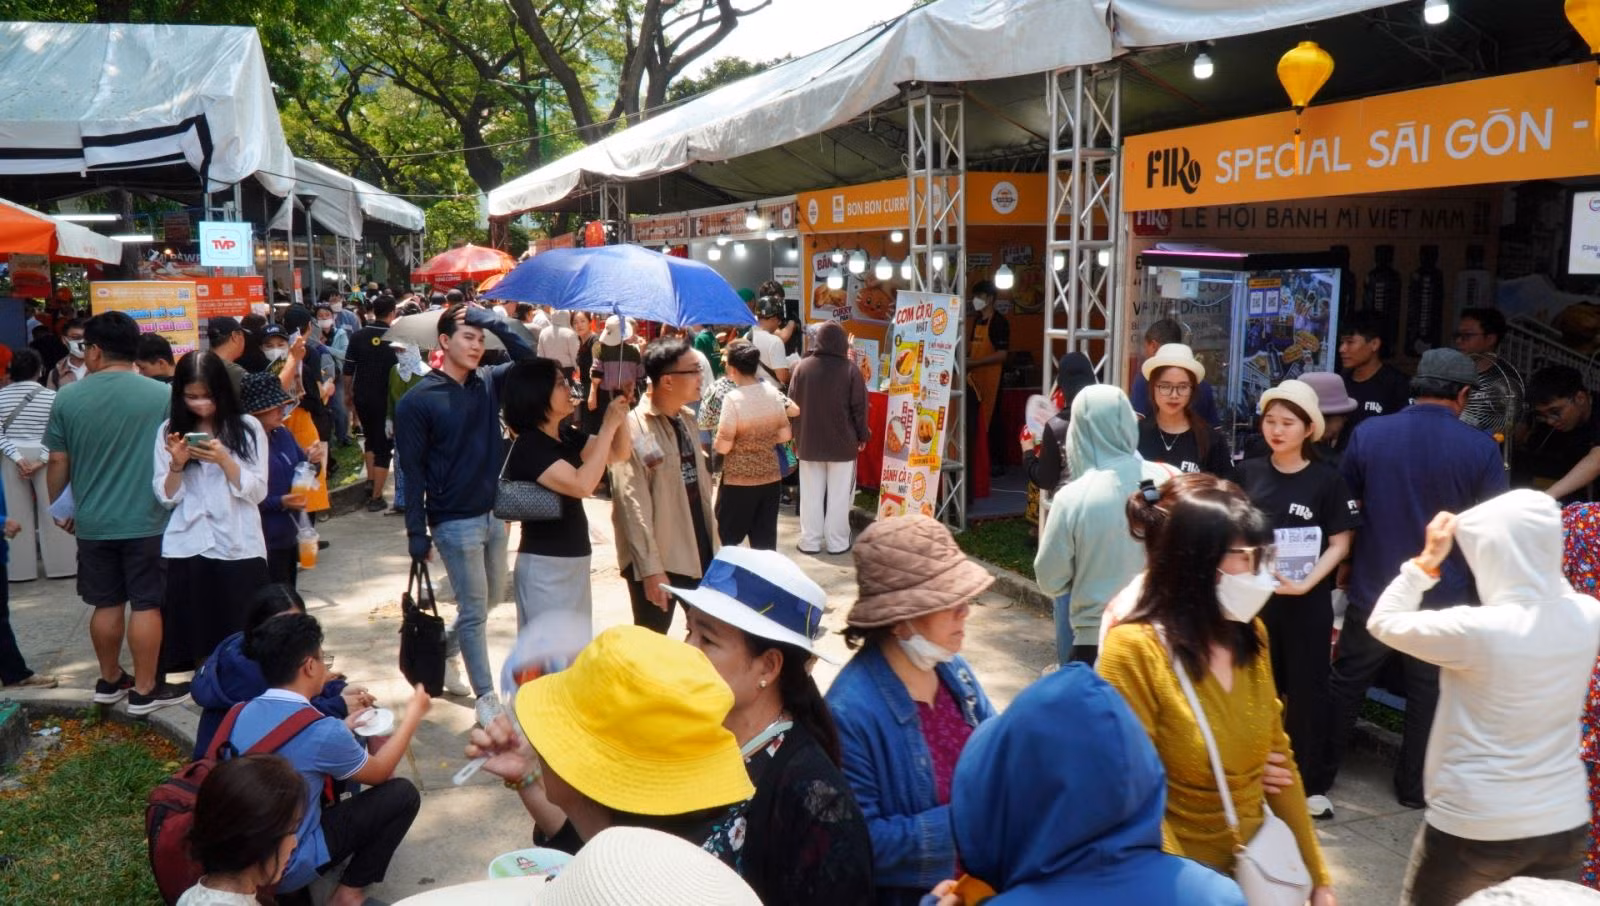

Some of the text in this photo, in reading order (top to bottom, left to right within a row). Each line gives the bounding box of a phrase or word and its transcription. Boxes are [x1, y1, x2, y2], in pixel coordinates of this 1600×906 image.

[1215, 136, 1351, 185] SPECIAL
[847, 203, 864, 217] BON
[864, 201, 882, 215] BON
[883, 196, 910, 214] CURRY
[1419, 208, 1466, 230] NAM
[211, 240, 236, 250] TVP
